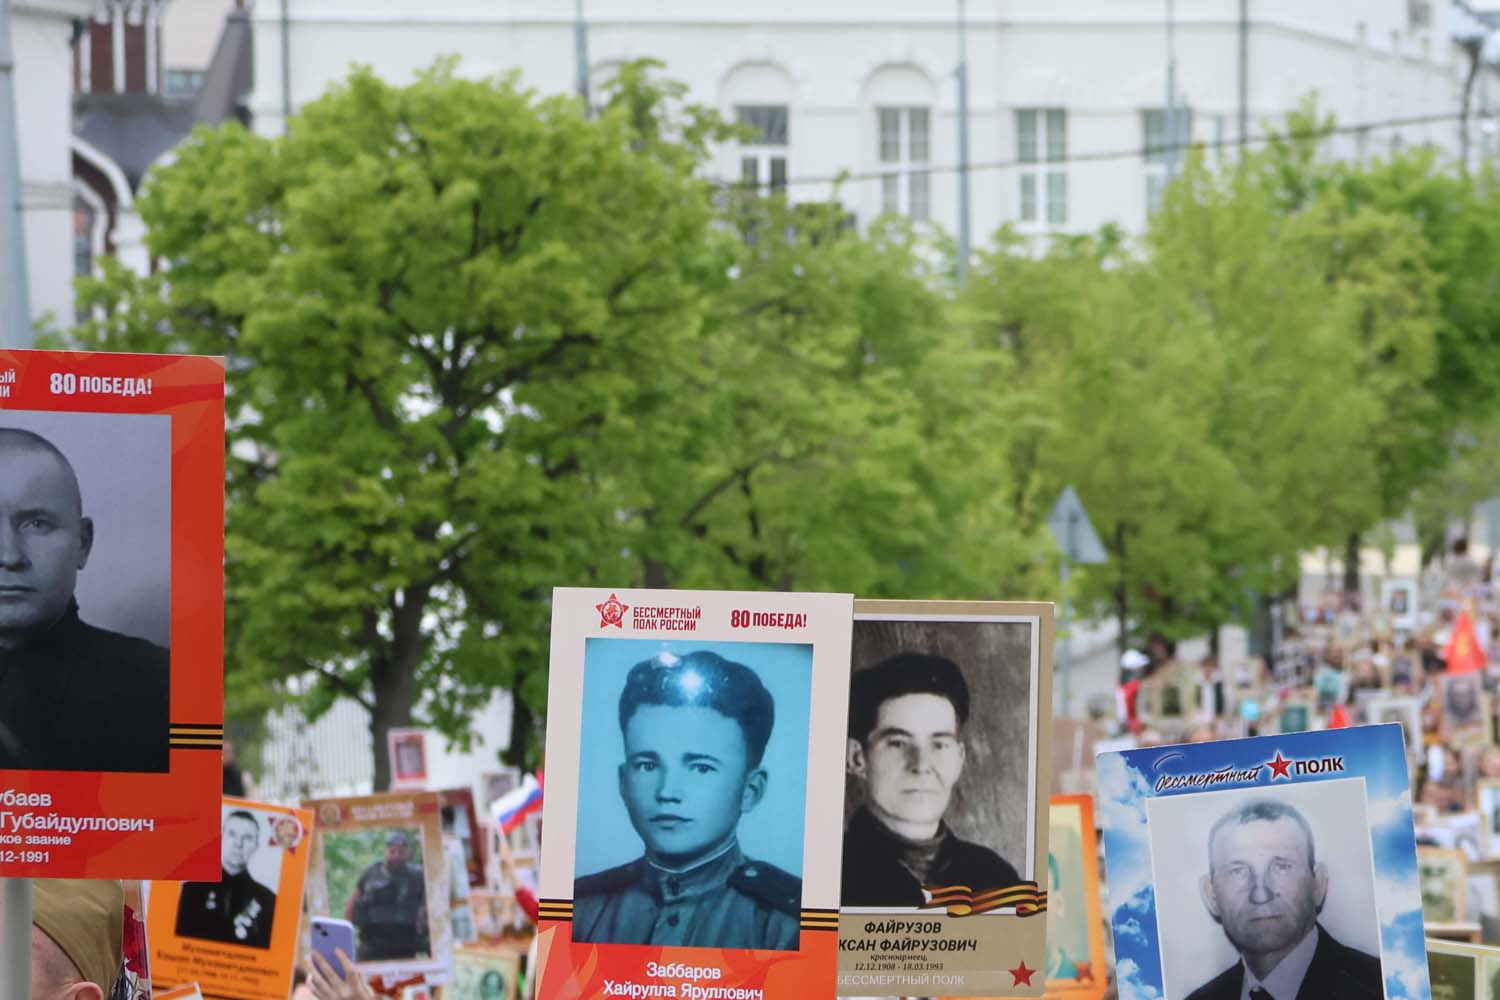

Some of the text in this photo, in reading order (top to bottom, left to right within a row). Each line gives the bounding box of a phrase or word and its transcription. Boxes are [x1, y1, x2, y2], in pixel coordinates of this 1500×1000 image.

[50, 372, 152, 397] 80 ПОБЕДА!
[633, 605, 701, 619] БЕССМЕРТНЫЙ
[731, 609, 807, 629] 80 ПОБЕДА!
[633, 619, 696, 630] ПОЛК РОССИИ
[1295, 757, 1345, 775] ПОЛК
[0, 811, 155, 834] Губайдуллович
[25, 835, 72, 845] звание
[864, 920, 942, 934] ФАЙРУЗОВ
[880, 938, 977, 951] ФАЙРУЗОВИЧ
[646, 962, 722, 982] Заббаров
[932, 974, 965, 985] ПОЛК
[602, 980, 676, 1000] Хайрулла
